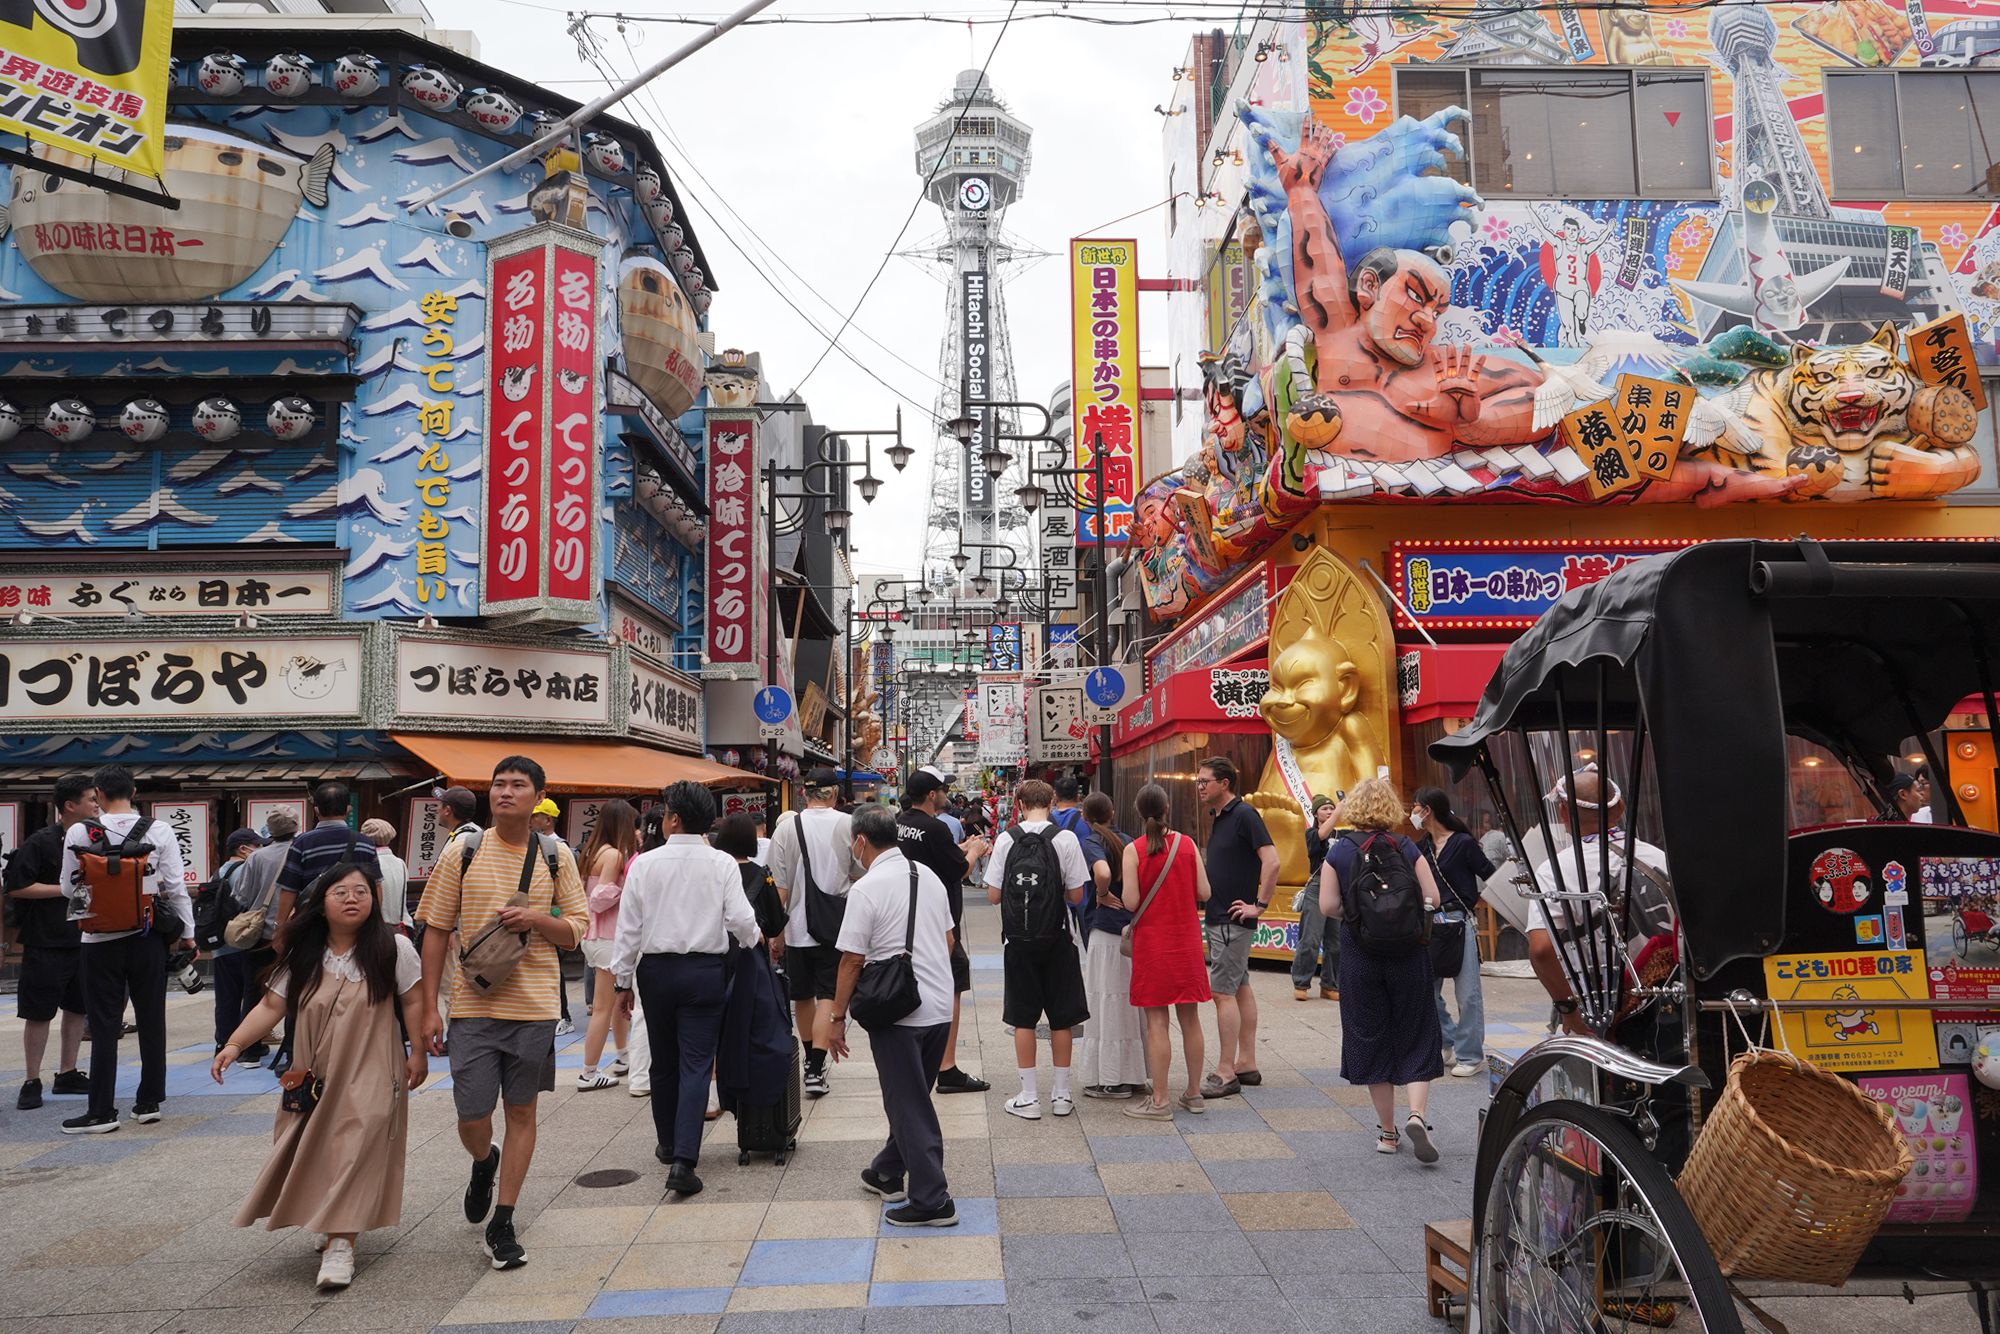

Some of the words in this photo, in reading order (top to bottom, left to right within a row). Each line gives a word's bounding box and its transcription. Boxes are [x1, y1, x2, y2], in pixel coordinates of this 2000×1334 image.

[1907, 0, 1934, 52] 物串かつ
[0, 50, 144, 119] 界遊技場
[35, 222, 204, 257] 私の味は日本一
[957, 209, 993, 219] HITACH
[1081, 246, 1127, 266] 新世界
[1885, 229, 1910, 292] 通天閣
[503, 269, 536, 353] 名物
[557, 269, 591, 353] 名物
[967, 275, 985, 339] Hitachi
[1090, 266, 1120, 403] 日本一の串かつ
[968, 343, 985, 400] Social
[1926, 325, 1976, 407] 千客万
[1576, 410, 1630, 489] 横綱
[1621, 384, 1653, 461] 串かつ
[1648, 390, 1681, 471] 日本一の
[1082, 405, 1133, 506] 横綱
[498, 411, 534, 583] てっちり
[553, 412, 588, 582] てっちり
[713, 463, 747, 655] 珍味てっちり
[1041, 460, 1074, 604] 田屋酒店
[0, 586, 51, 607] 珍味
[1410, 560, 1431, 612] 新世界
[1431, 569, 1561, 600] 日本一の串かつ
[409, 663, 599, 703] づぼらや本店
[629, 672, 698, 735] ふぐ料理専門
[419, 803, 438, 861] にぎり盛合せ
[1776, 955, 1914, 979] こども110番の家
[1864, 1083, 1888, 1100] Ice
[1890, 1077, 1950, 1100] cream!
